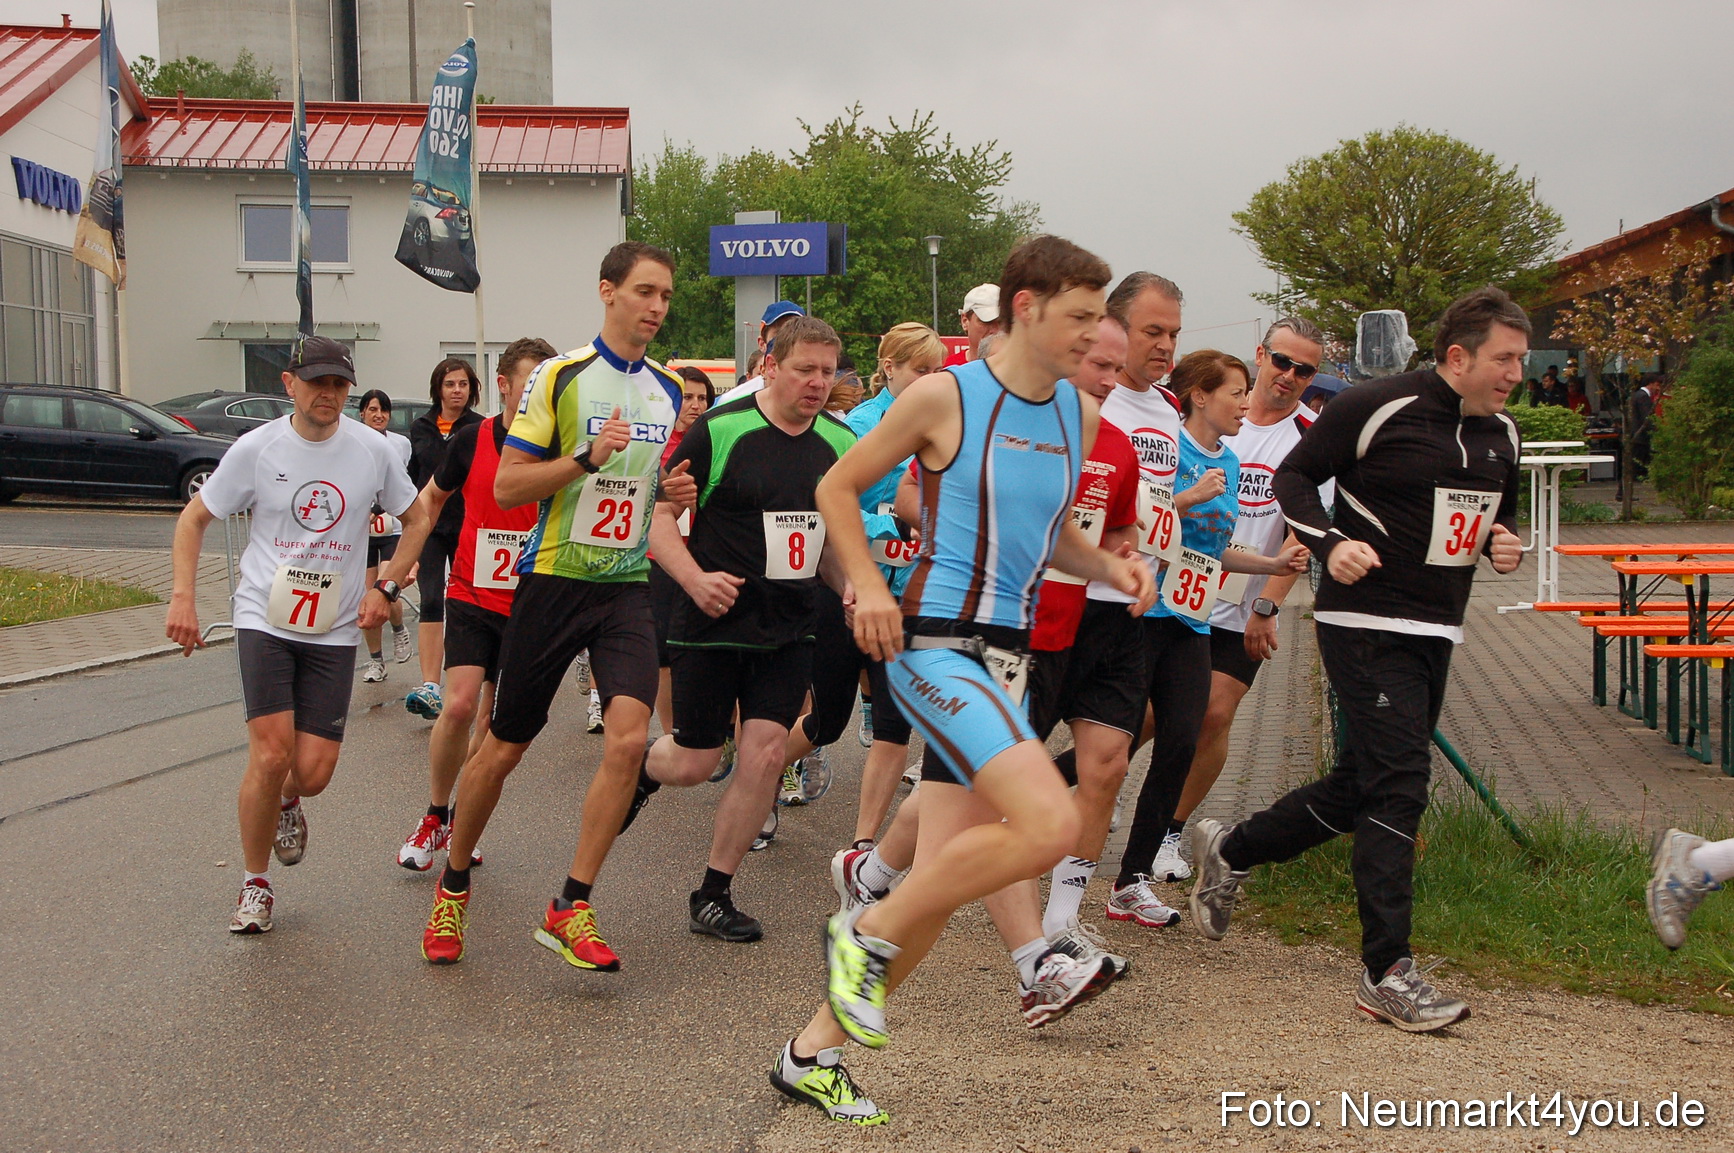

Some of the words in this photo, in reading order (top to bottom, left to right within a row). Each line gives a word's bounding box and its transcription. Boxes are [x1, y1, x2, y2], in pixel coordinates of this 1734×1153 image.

[10, 155, 82, 215] VOLVO
[720, 238, 811, 258] VOLVO
[587, 416, 668, 444] BCK
[595, 478, 628, 489] MEYER
[595, 486, 627, 496] WERBUNG
[1447, 493, 1479, 504] MEYER
[1447, 502, 1479, 511] WERBUNG
[590, 498, 634, 541] 23
[775, 515, 806, 523] MEYER
[776, 522, 807, 530] WERBUNG
[1147, 505, 1174, 551] 79
[487, 532, 518, 541] MEYER
[1445, 511, 1482, 556] 34
[309, 541, 326, 549] MIT
[328, 540, 352, 552] HERZ
[487, 539, 518, 547] WERBUNG
[788, 531, 805, 571] 8
[1181, 549, 1206, 566] MEYER
[287, 568, 320, 581] MEYER
[286, 577, 319, 587] WERBUNG
[1172, 568, 1208, 611] 35
[288, 588, 321, 628] 71
